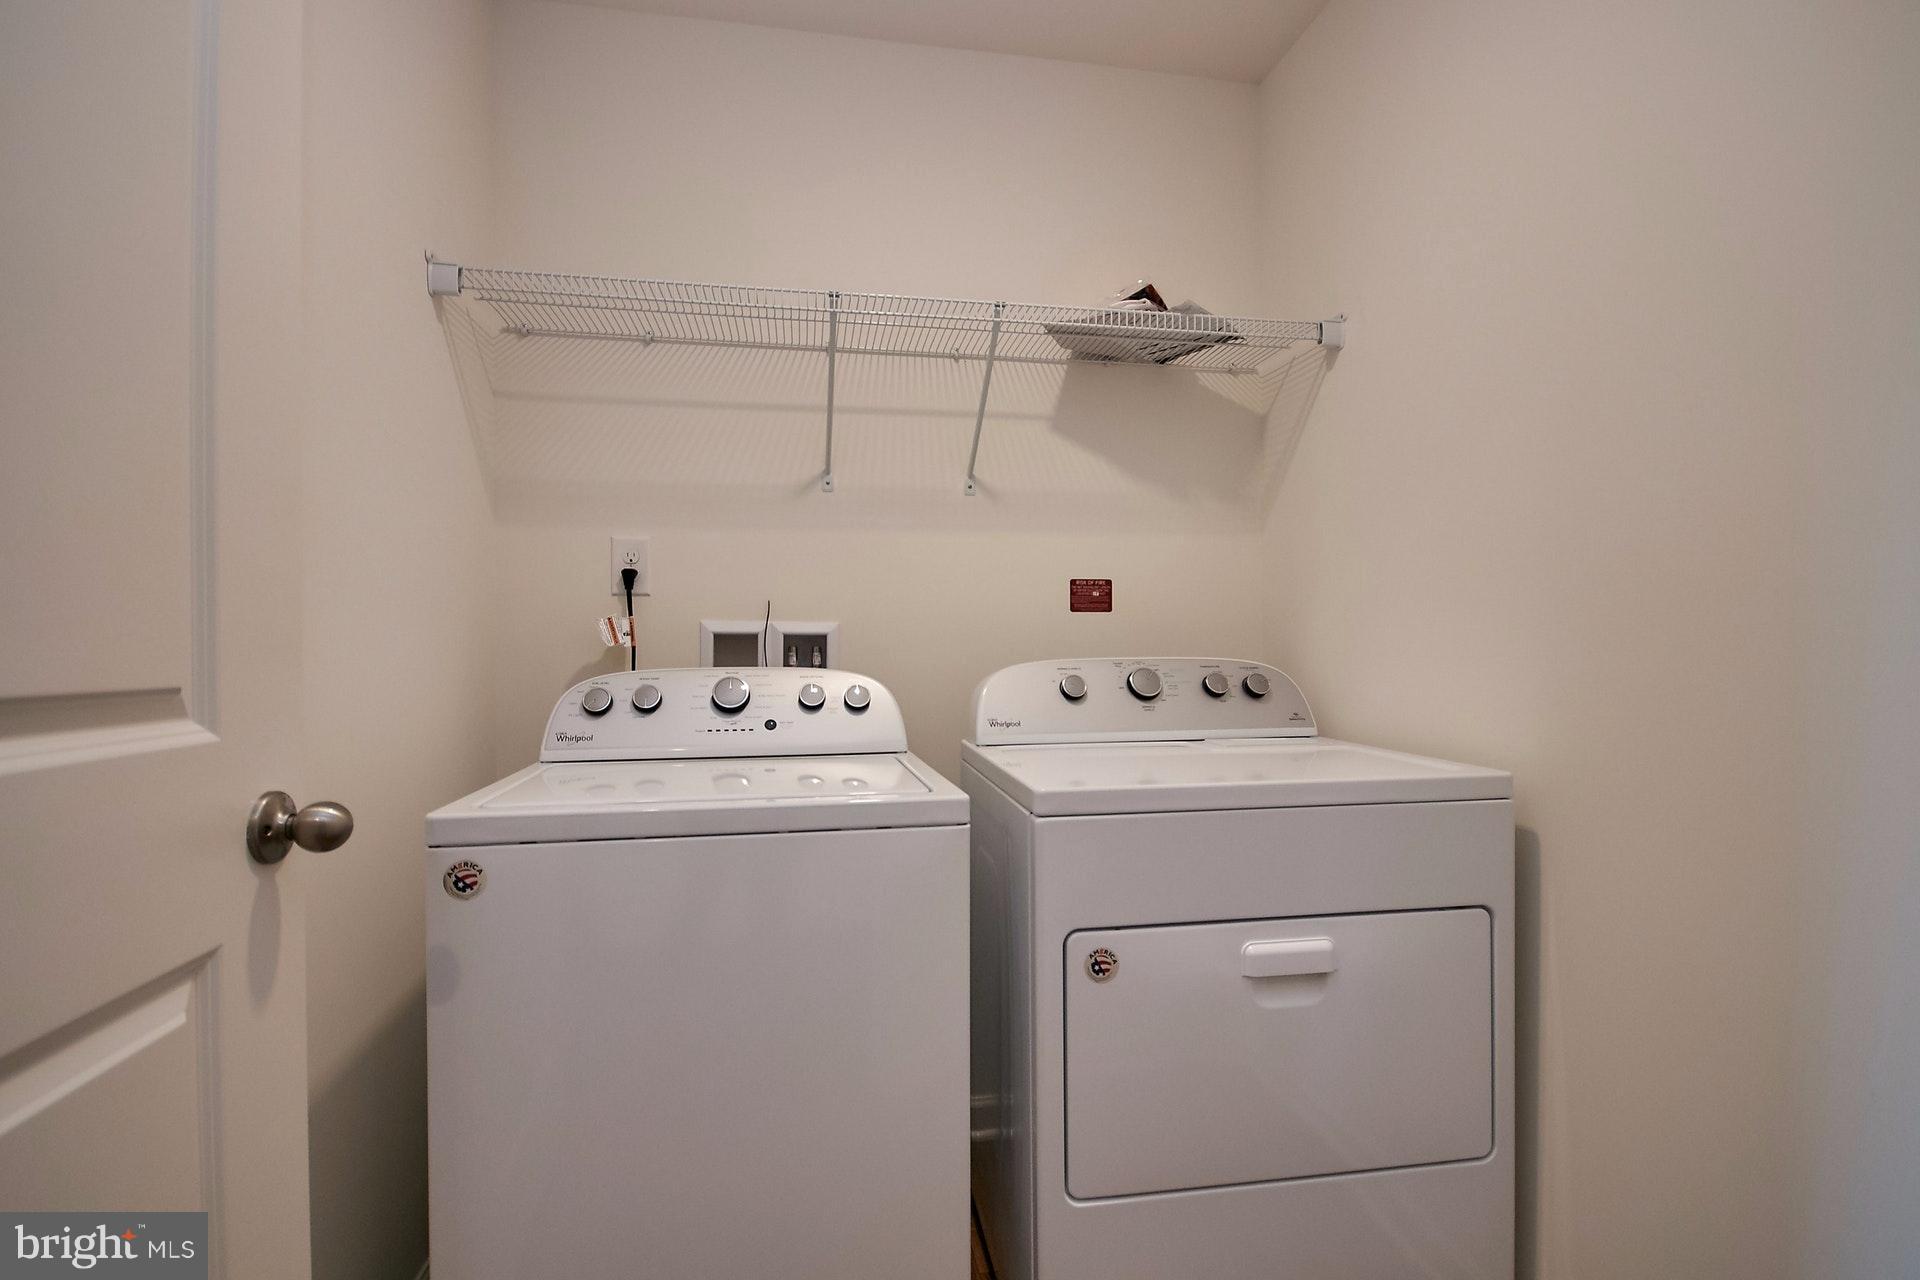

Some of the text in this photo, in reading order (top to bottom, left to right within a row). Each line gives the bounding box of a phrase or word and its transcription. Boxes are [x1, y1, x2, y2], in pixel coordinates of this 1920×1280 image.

[988, 720, 1021, 728] Whirlpool
[555, 734, 594, 743] Whirlpool
[447, 861, 483, 879] AMERICA
[1089, 948, 1118, 965] AMERICA
